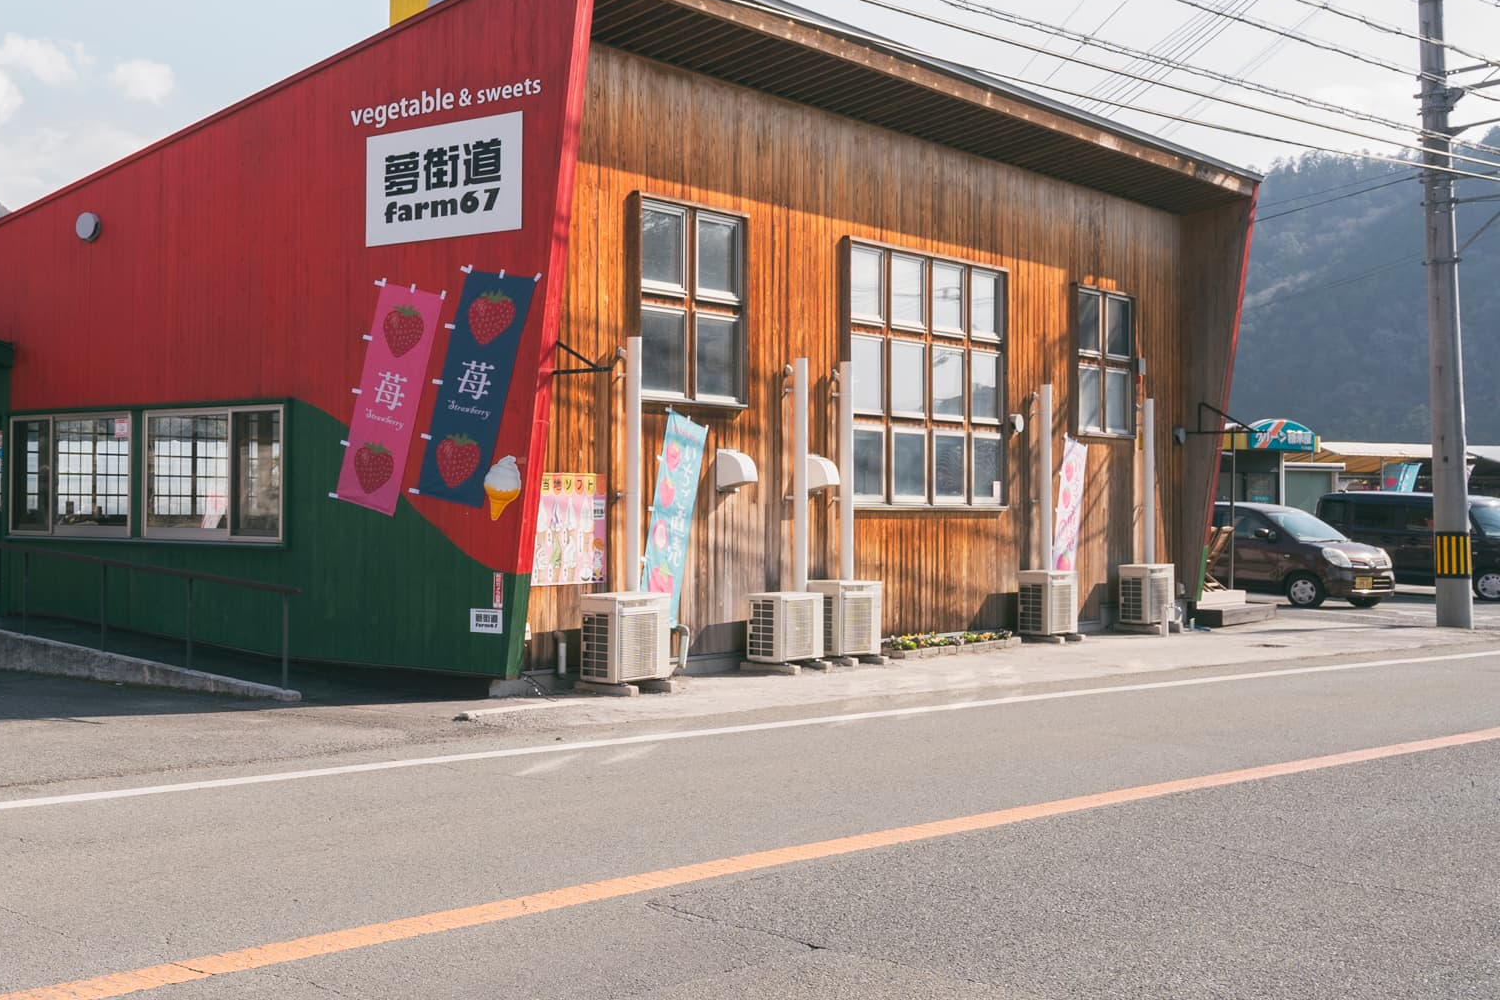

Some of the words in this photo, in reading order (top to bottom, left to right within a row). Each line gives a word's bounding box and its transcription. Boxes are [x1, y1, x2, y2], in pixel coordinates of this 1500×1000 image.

[350, 88, 454, 128] vegetable
[458, 88, 473, 107] &
[476, 77, 542, 105] sweets
[384, 138, 502, 198] 夢街道
[384, 187, 501, 224] farm67
[374, 371, 408, 411] 苺
[457, 359, 496, 401] 苺
[365, 408, 405, 431] Strawberry
[447, 399, 491, 420] Strawberry
